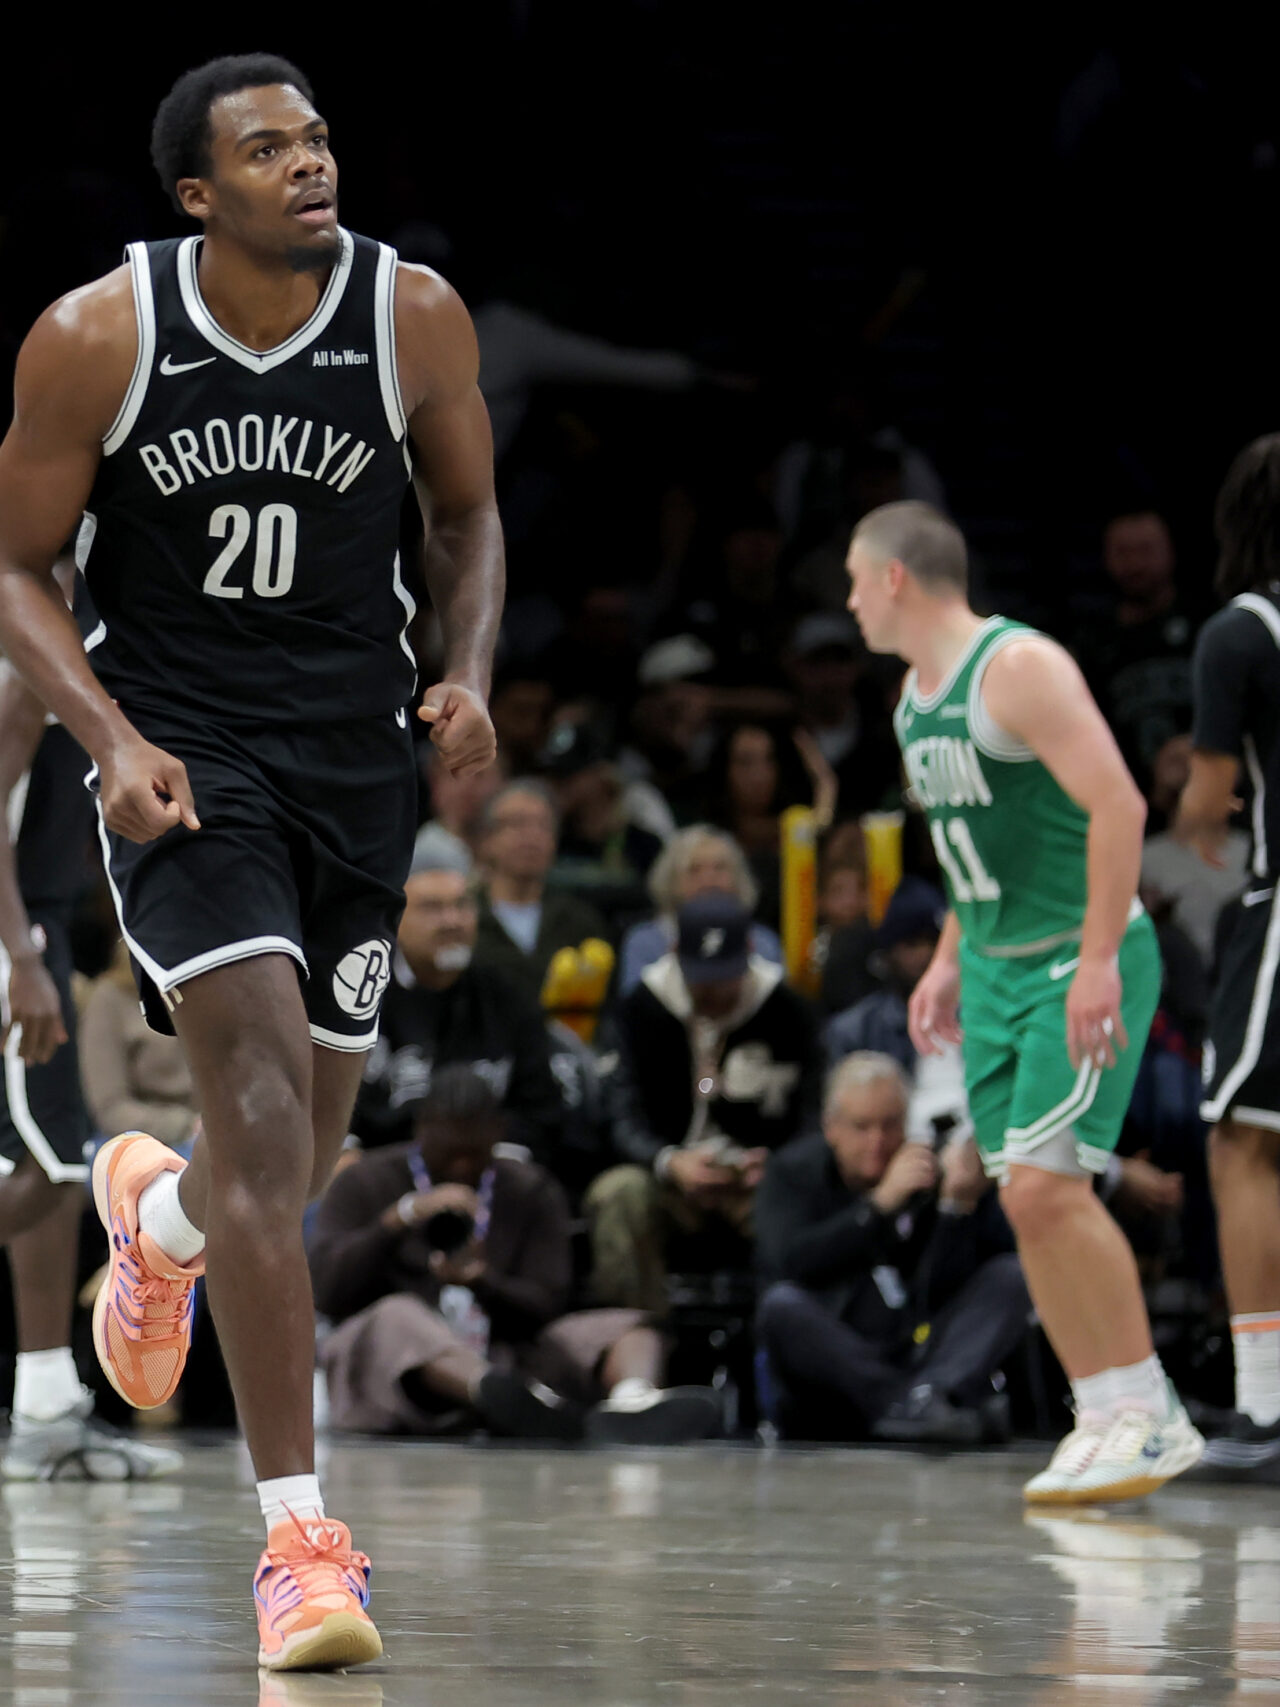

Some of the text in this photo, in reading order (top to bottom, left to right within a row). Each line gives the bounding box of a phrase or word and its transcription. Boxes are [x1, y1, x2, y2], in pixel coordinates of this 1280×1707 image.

[312, 349, 369, 367] All In Won
[138, 413, 376, 496] BROOKLYN
[203, 503, 298, 599] 20
[930, 817, 1001, 902] 11
